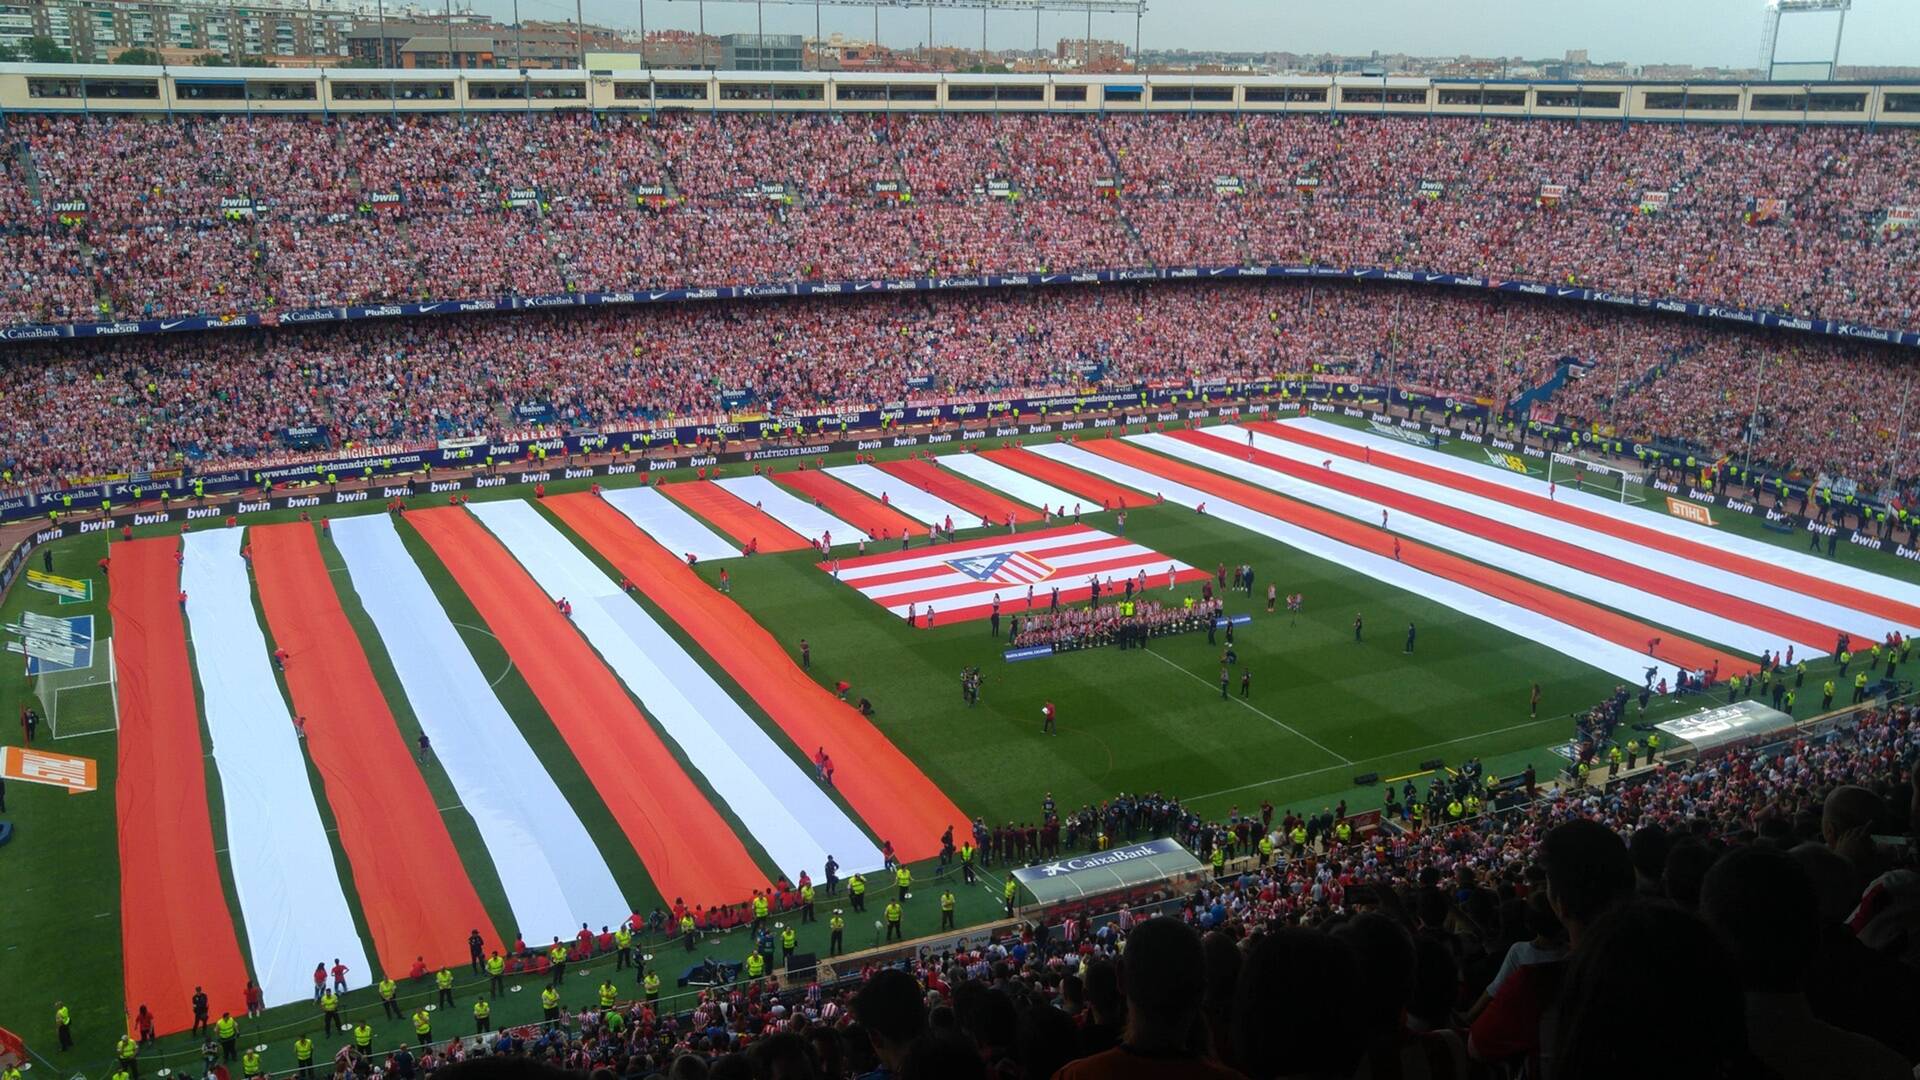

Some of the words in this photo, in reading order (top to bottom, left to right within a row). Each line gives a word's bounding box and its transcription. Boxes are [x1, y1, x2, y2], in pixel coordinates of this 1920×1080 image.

[511, 189, 536, 198] bwin
[638, 185, 663, 195] bwin
[221, 197, 250, 207] bwin
[372, 193, 399, 202] bwin
[753, 286, 787, 295] CaixaBank
[292, 311, 334, 321] CaixaBank
[8, 328, 59, 338] CaixaBank
[96, 325, 139, 334] Plus500
[1849, 326, 1888, 340] CaixaBank
[917, 405, 940, 417] bwin
[1312, 402, 1334, 412] bwin
[1344, 407, 1363, 418] bwin
[1127, 415, 1147, 425] bwin
[1158, 412, 1178, 422] bwin
[1189, 410, 1209, 419] bwin
[1372, 412, 1391, 424] bwin
[1030, 423, 1051, 433] bwin
[1062, 420, 1083, 430] bwin
[1095, 418, 1116, 428] bwin
[1401, 419, 1421, 430] bwin
[963, 430, 985, 440] bwin
[997, 426, 1018, 436] bwin
[894, 436, 917, 446] bwin
[929, 433, 951, 443] bwin
[1461, 431, 1482, 443] bwin
[490, 444, 519, 455] bwin
[858, 440, 881, 450] bwin
[1492, 438, 1514, 451] bwin
[753, 447, 789, 459] ATLÉTICO
[790, 448, 800, 456] DE
[802, 445, 829, 455] MADRID
[1524, 446, 1544, 458] bwin
[262, 455, 420, 478] www.atletiodemadridstre.com
[650, 460, 677, 471] bwin
[691, 456, 717, 467] bwin
[565, 467, 593, 479] bwin
[608, 463, 636, 475] bwin
[477, 476, 506, 488] bwin
[521, 471, 550, 483] bwin
[129, 482, 171, 493] CixaBank
[431, 481, 460, 493] bwin
[1654, 479, 1678, 493] bwin
[336, 491, 367, 503] bwin
[1689, 488, 1714, 503] bwin
[238, 501, 271, 513] bwin
[288, 496, 319, 508] bwin
[1727, 498, 1753, 514] bwin
[187, 505, 220, 519] bwin
[1673, 503, 1703, 520] STIHL
[134, 512, 169, 525] bwin
[80, 520, 115, 533] bwin
[37, 529, 62, 544] bwin
[1851, 531, 1881, 549] bwin
[1068, 845, 1156, 871] CaixaBank
